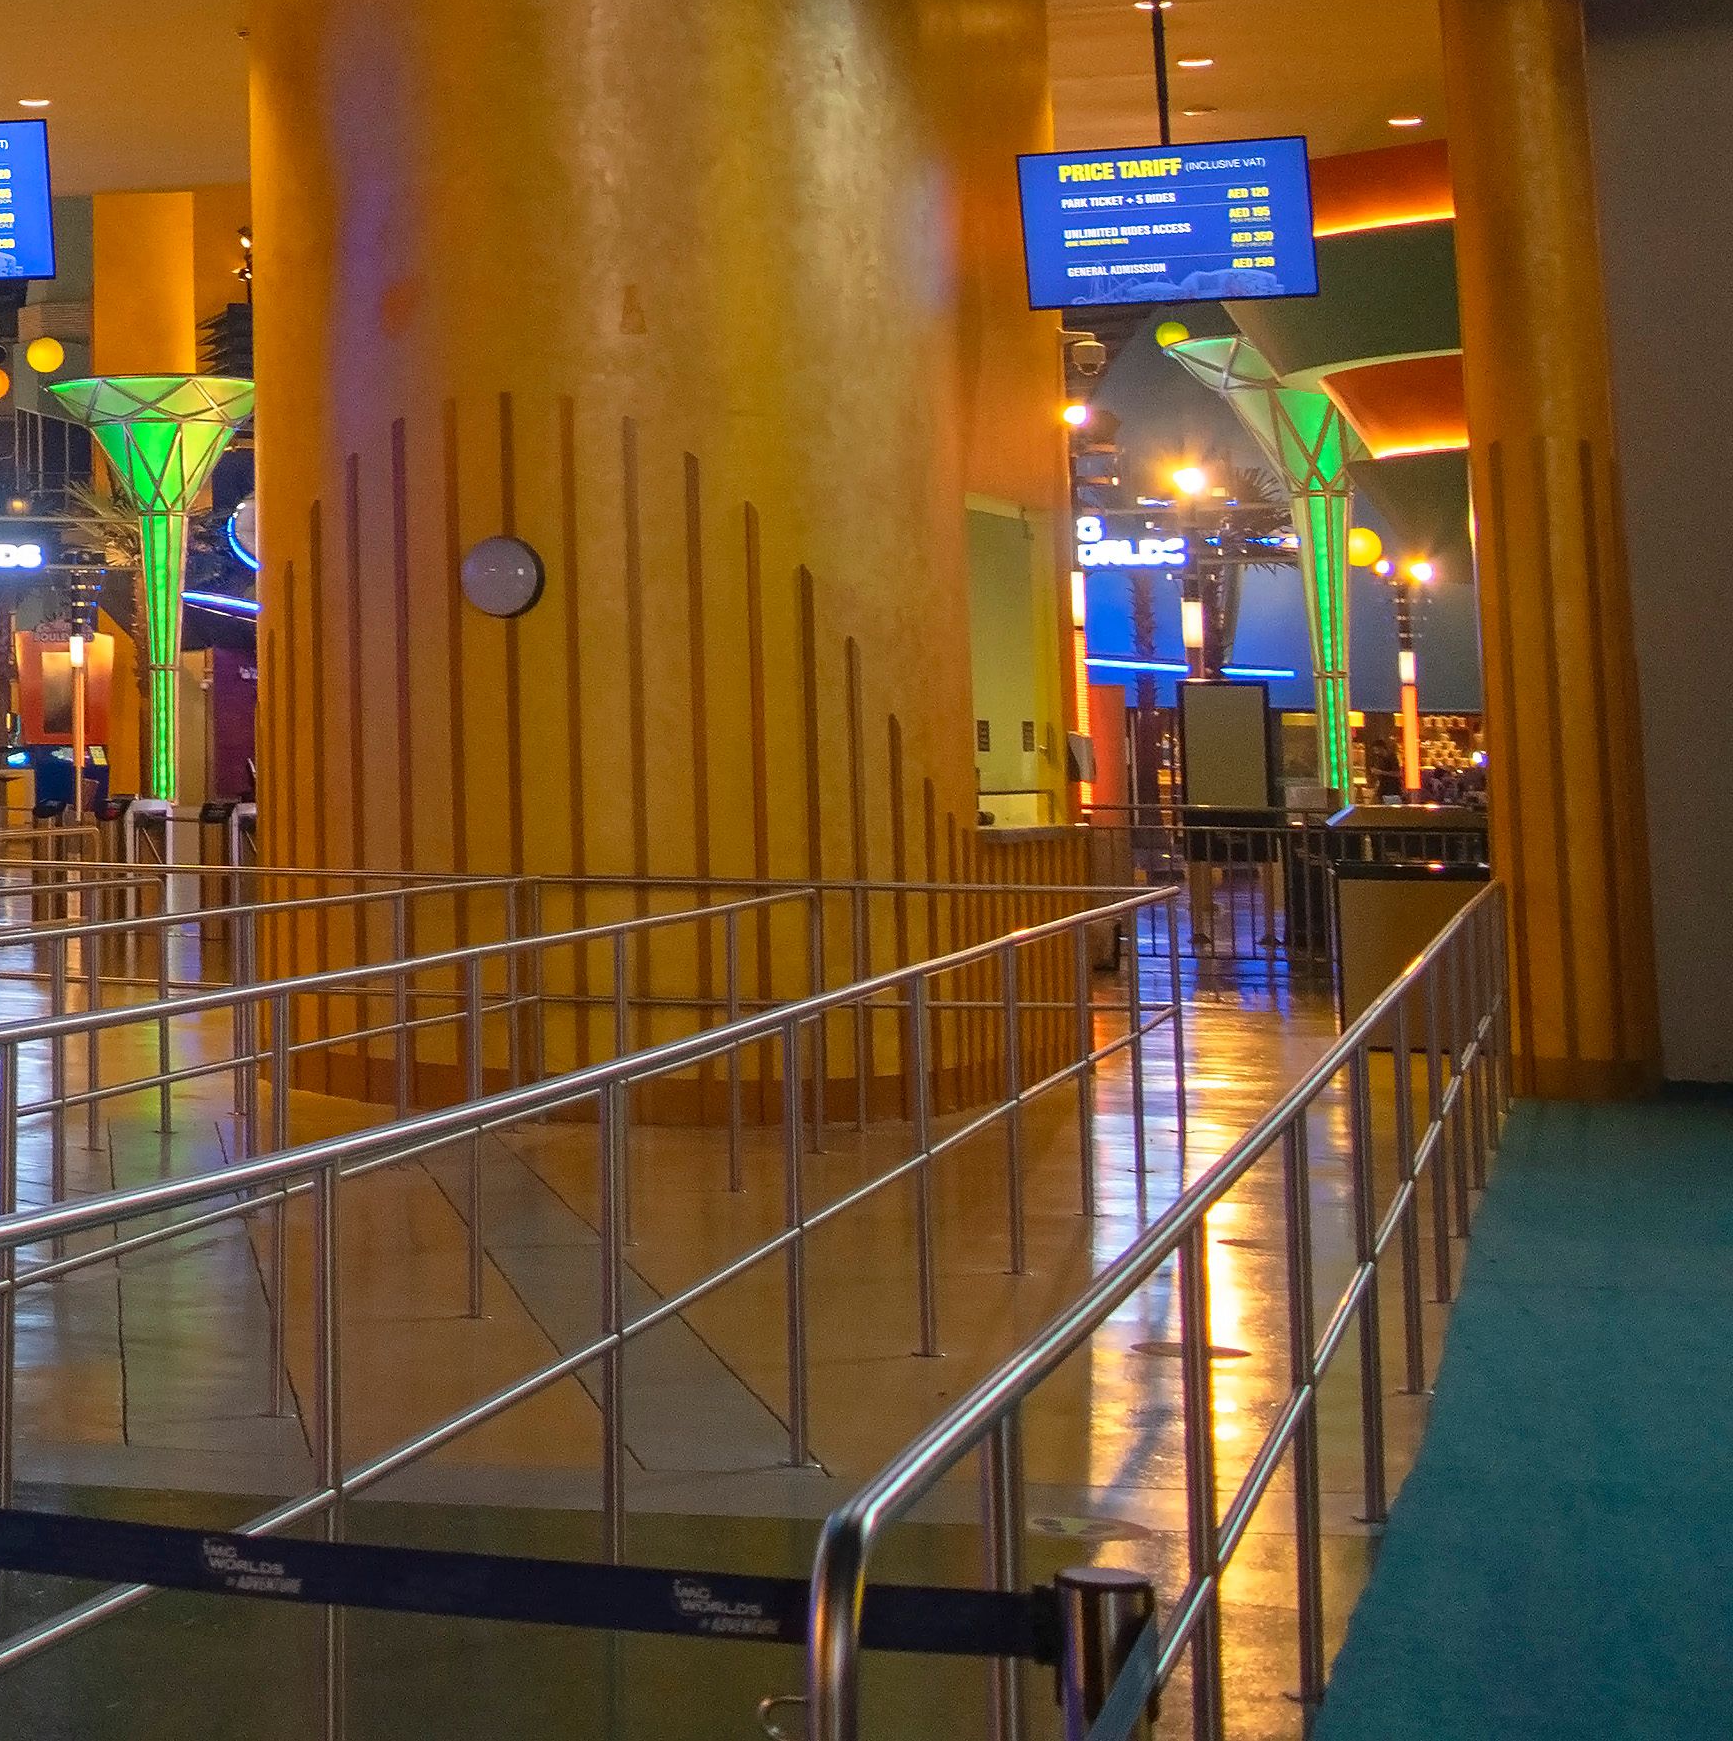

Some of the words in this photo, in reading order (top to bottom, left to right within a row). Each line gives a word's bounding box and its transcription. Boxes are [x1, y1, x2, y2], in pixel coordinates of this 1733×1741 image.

[1058, 162, 1115, 183] PRICE
[1117, 157, 1182, 179] TARIFF
[1185, 161, 1240, 172] (INCLUSIVE
[1242, 157, 1266, 170] VAT)
[1061, 198, 1087, 209] PARK
[1089, 196, 1124, 207] TICKET
[1078, 537, 1185, 566] ORLDS
[208, 1557, 284, 1575] WORLDS
[681, 1600, 762, 1615] WORLDS
